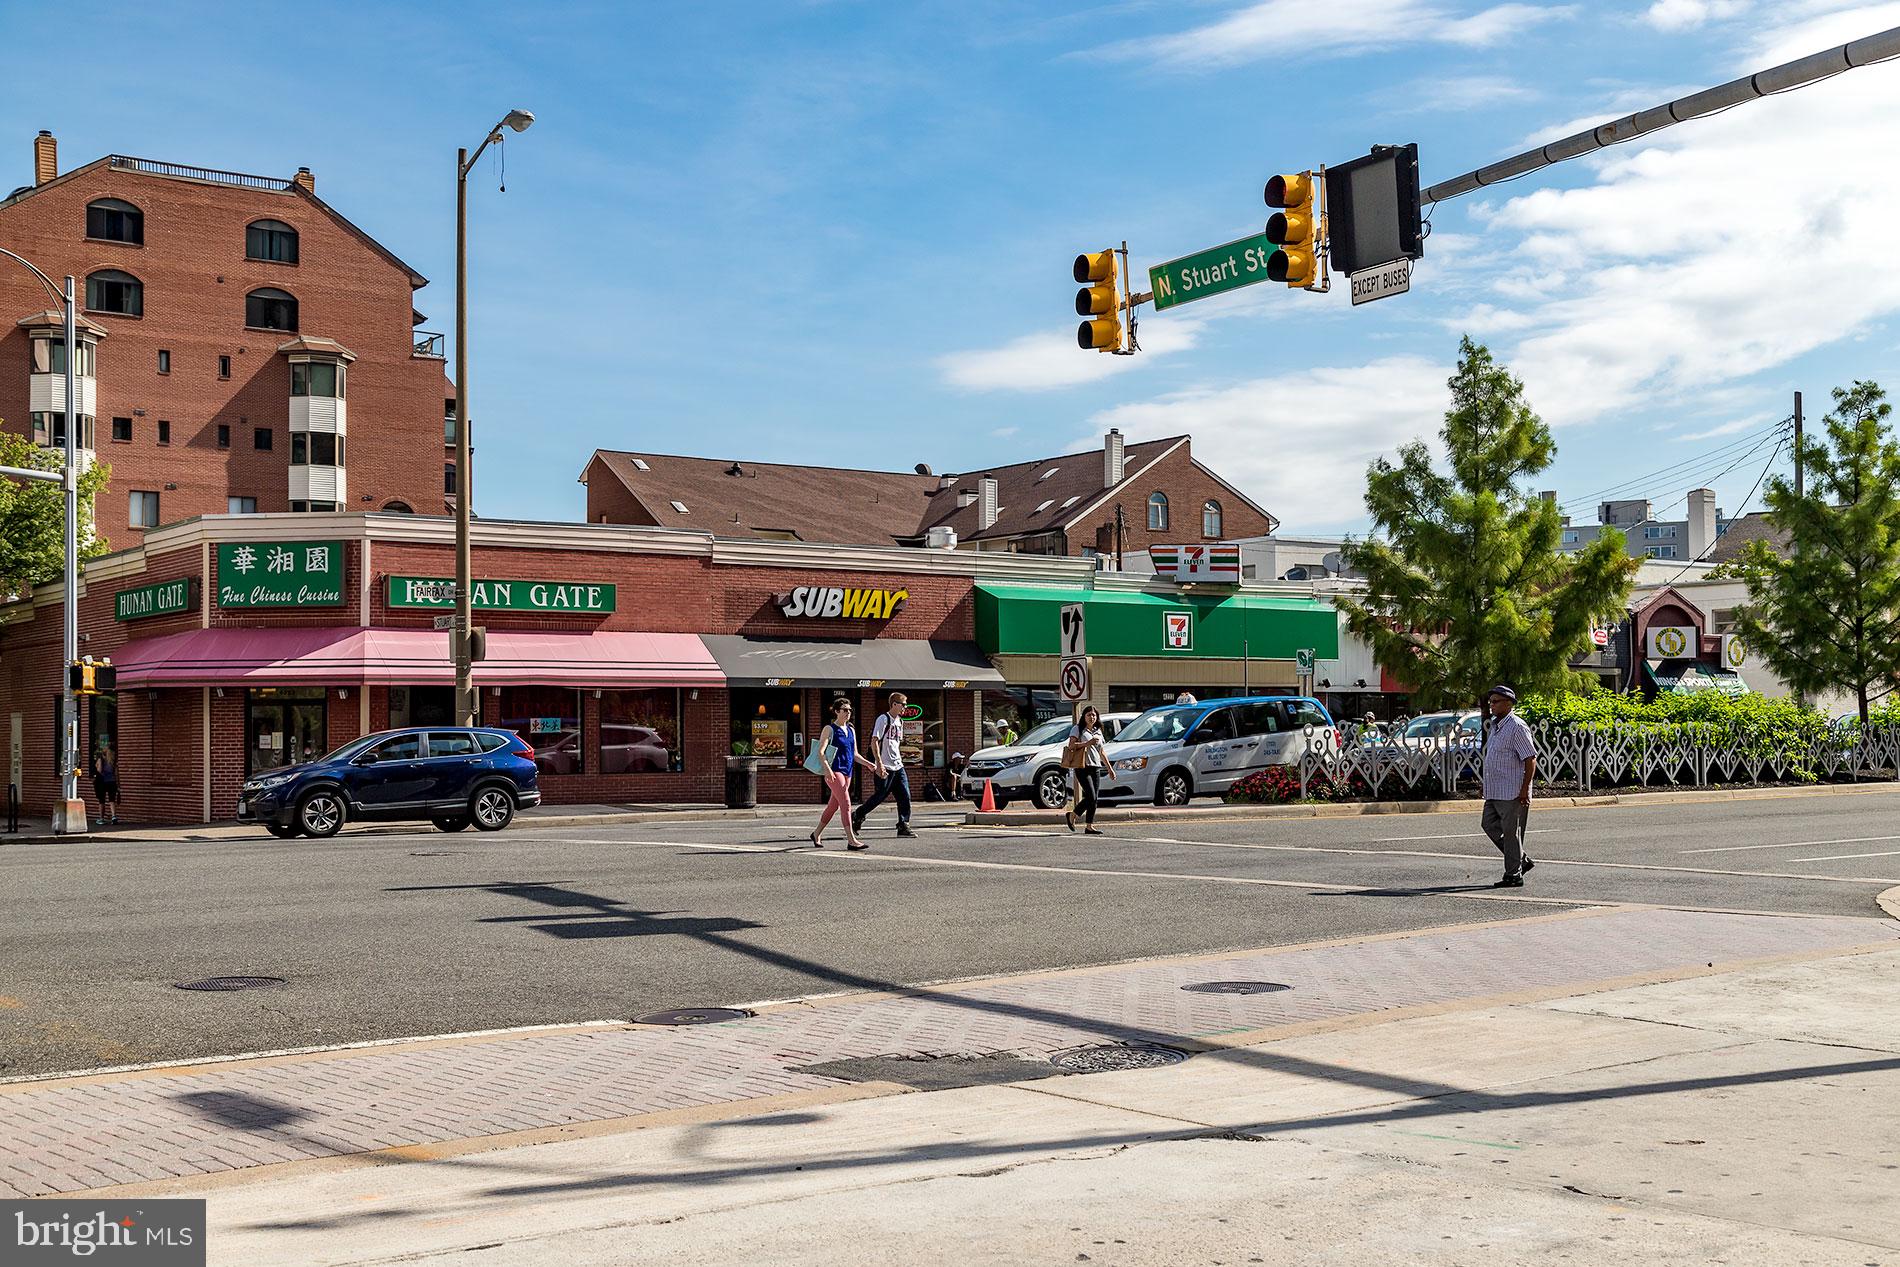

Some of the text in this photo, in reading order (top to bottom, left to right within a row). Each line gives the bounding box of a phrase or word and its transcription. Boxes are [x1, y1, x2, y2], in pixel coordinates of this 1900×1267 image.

[1158, 246, 1267, 298] N. Stuart St
[1353, 268, 1407, 297] EXCEPT BUSES
[231, 546, 329, 575] 華湘園
[1185, 547, 1204, 573] 7
[119, 583, 184, 616] HUNAN GATE
[221, 585, 340, 605] Fine Chinese Cuisine
[416, 587, 446, 597] FAIRFAX
[530, 585, 602, 608] GATE
[783, 587, 910, 619] SUBWAY
[1171, 618, 1185, 646] 7
[765, 678, 794, 688] SUBWAY
[857, 679, 885, 688] SUBWAY
[942, 680, 969, 689] SUBWAY
[1652, 676, 1679, 687] WINGS
